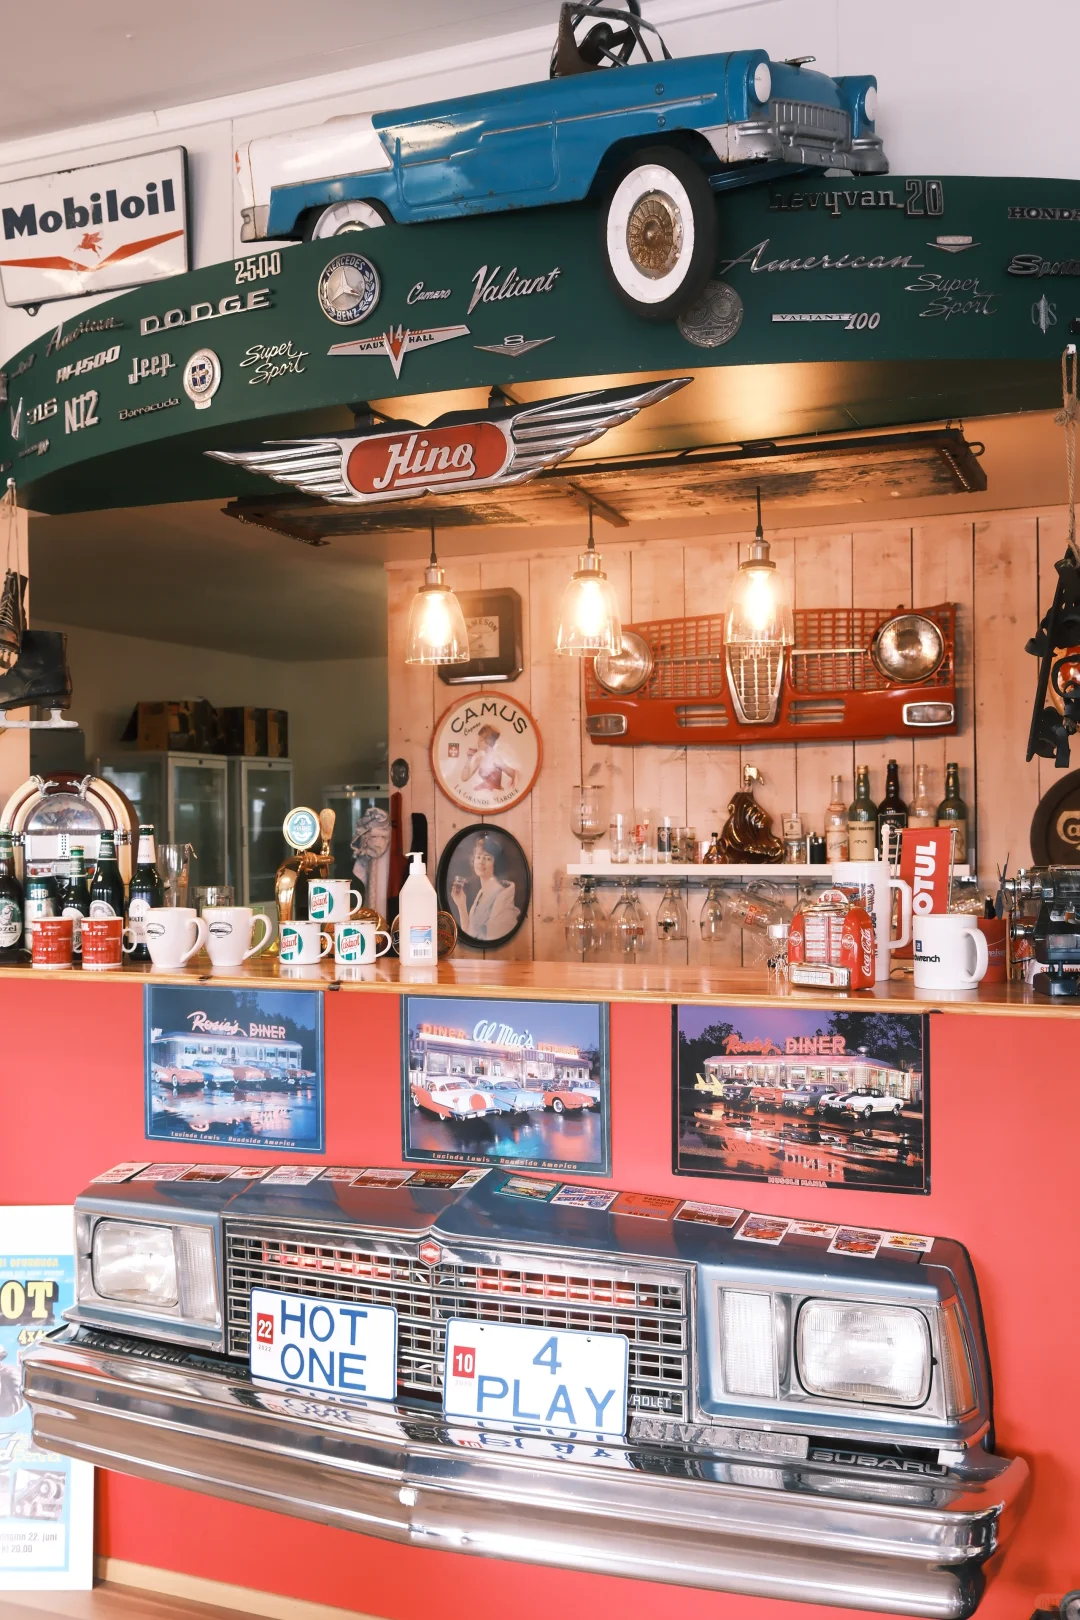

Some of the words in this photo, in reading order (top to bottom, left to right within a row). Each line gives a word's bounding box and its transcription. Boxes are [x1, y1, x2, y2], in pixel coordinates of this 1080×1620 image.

[2, 179, 175, 240] Mobiloil
[905, 179, 943, 215] 20
[234, 252, 281, 284] 2500
[326, 256, 366, 277] MERCEDES
[719, 239, 924, 275] American
[406, 281, 452, 305] Camaro
[466, 265, 562, 315] Valiant
[904, 274, 987, 297] Super
[140, 288, 270, 336] DODGE
[336, 308, 360, 321] BENZ
[919, 292, 1002, 321] Sport
[844, 312, 880, 329] 100
[46, 317, 124, 357] American
[359, 341, 385, 351] VAUX
[408, 334, 435, 344] HALL
[240, 340, 298, 367] Super
[128, 353, 176, 385] Jeep
[248, 350, 309, 385] Sport
[118, 397, 180, 421] Barracuda
[373, 434, 474, 489] Hino
[467, 618, 498, 633] AMESON
[451, 703, 528, 734] CAMUS
[341, 934, 360, 953] Castrol
[187, 1011, 247, 1037] Rosie's
[249, 1022, 286, 1039] DINER
[422, 1024, 466, 1039] DINER
[496, 1024, 535, 1049] Mac's
[785, 1035, 846, 1055] DINER
[171, 1131, 198, 1139] Lucinda
[200, 1133, 220, 1141] Lewis
[228, 1136, 261, 1144] Roadside
[264, 1139, 296, 1147] America
[432, 1152, 464, 1161] Lucinda
[467, 1155, 490, 1163] Lewis
[500, 1158, 538, 1167] Roadside
[542, 1161, 577, 1170] America
[768, 1176, 800, 1187] MUSCLE
[801, 1179, 827, 1188] MANIA
[258, 1318, 273, 1340] 22
[280, 1299, 368, 1346] HOT
[257, 1344, 273, 1353] 2022
[454, 1351, 474, 1373] 10
[532, 1336, 562, 1376] 4
[280, 1343, 368, 1392] ONE
[476, 1374, 617, 1428] PLAY
[811, 1449, 949, 1476] SUBARU
